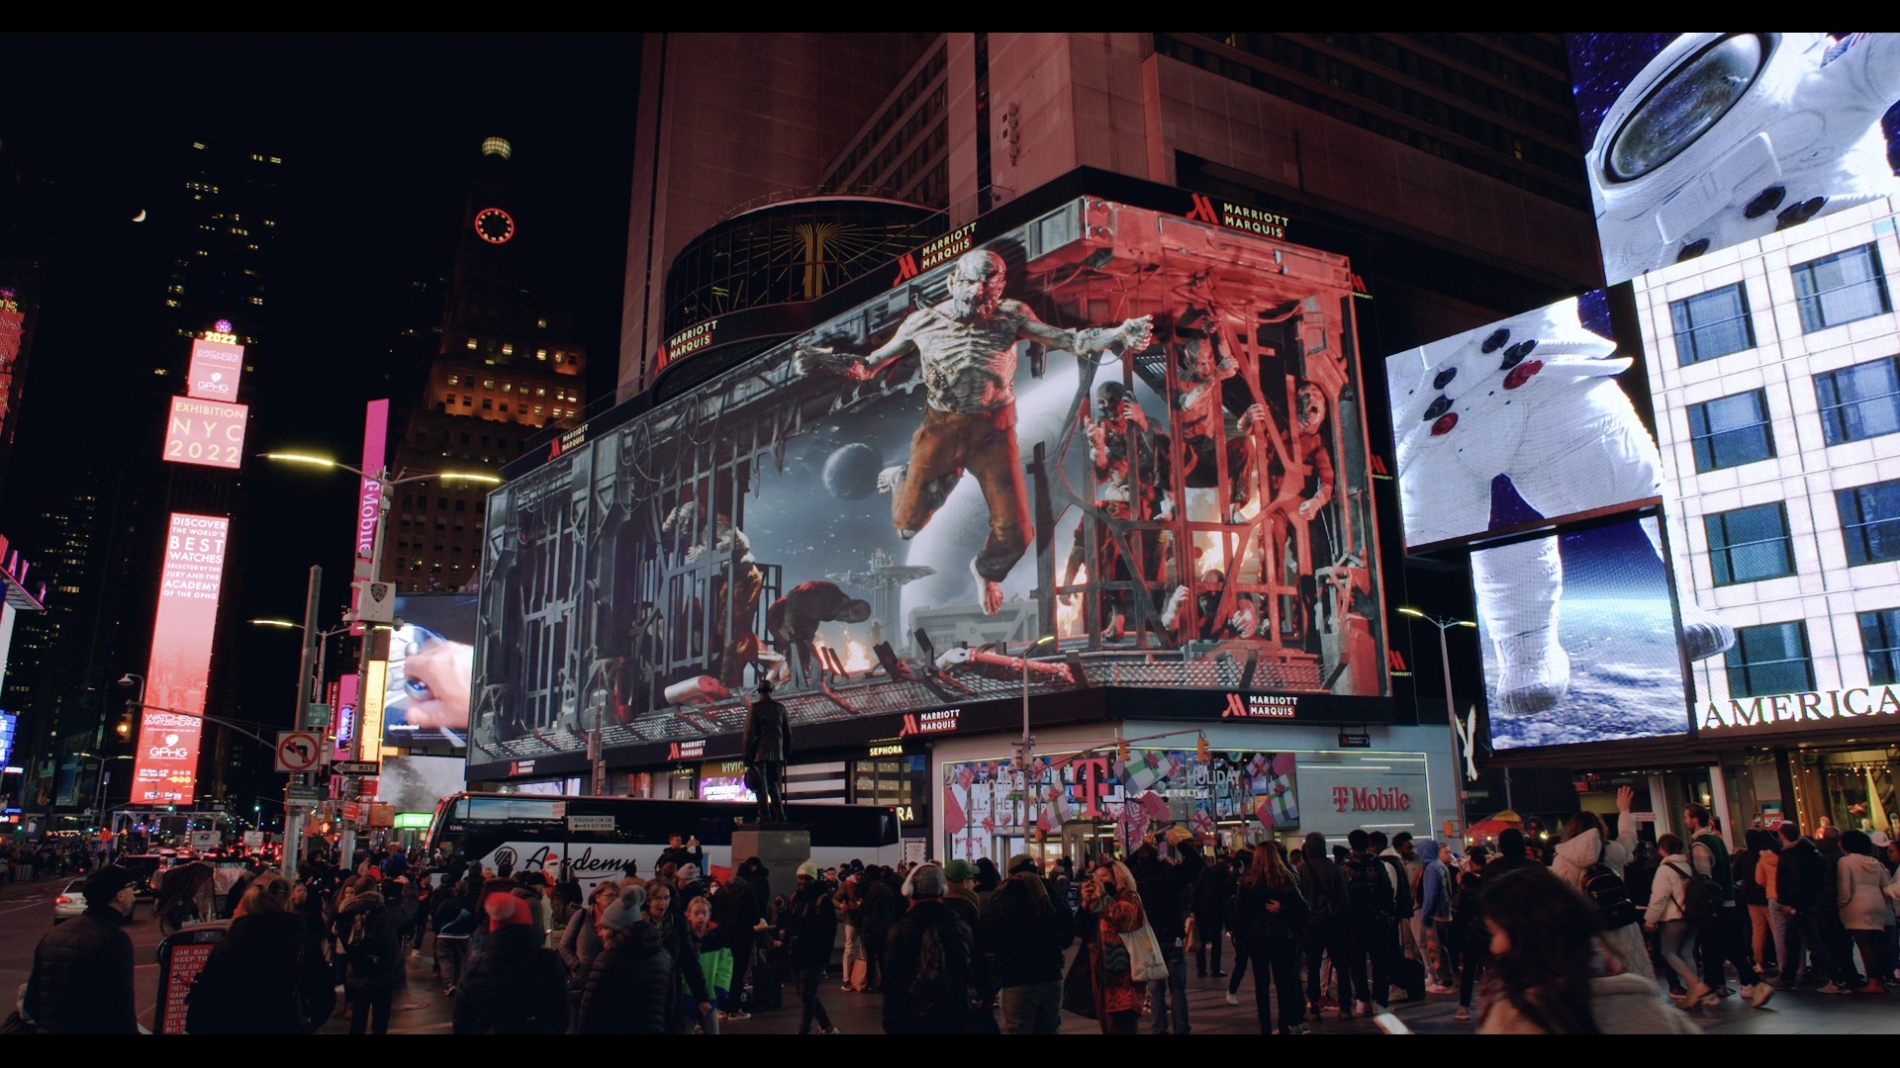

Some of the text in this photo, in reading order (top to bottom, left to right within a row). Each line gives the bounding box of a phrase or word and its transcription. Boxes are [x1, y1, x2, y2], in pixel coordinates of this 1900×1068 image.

[1223, 202, 1290, 227] MARRIOTT
[1225, 216, 1283, 239] MARQUIS
[922, 222, 977, 257] MARRIOTT
[922, 238, 970, 269] MARQUIS
[204, 331, 238, 345] 2022
[670, 320, 718, 348] MARRIOTT
[670, 335, 710, 360] MARQUIS
[175, 402, 245, 420] EXHIBITION
[562, 423, 589, 443] MARRIOTT
[169, 439, 239, 463] 2022
[172, 516, 227, 530] DISCOVER
[189, 528, 226, 538] WORLD'S
[169, 535, 224, 554] BEST
[169, 551, 222, 564] WATCHES
[167, 562, 199, 571] SELECTED
[164, 579, 219, 591] ACADEMY
[162, 589, 217, 600] OF THE GPHG
[1249, 695, 1298, 705] MARRIOTT
[145, 713, 194, 722] WATCHES
[920, 708, 960, 722] MARRIOTT
[1250, 706, 1293, 716] MARQUIS
[920, 720, 956, 731] MARQUIS
[681, 740, 706, 749] MARRIOTT
[869, 745, 903, 757] SEPHORA
[149, 746, 188, 758] GPHG
[681, 748, 703, 757] MARQUIS
[337, 762, 375, 771] ONE WAY
[1186, 769, 1241, 785] HOLIDAY
